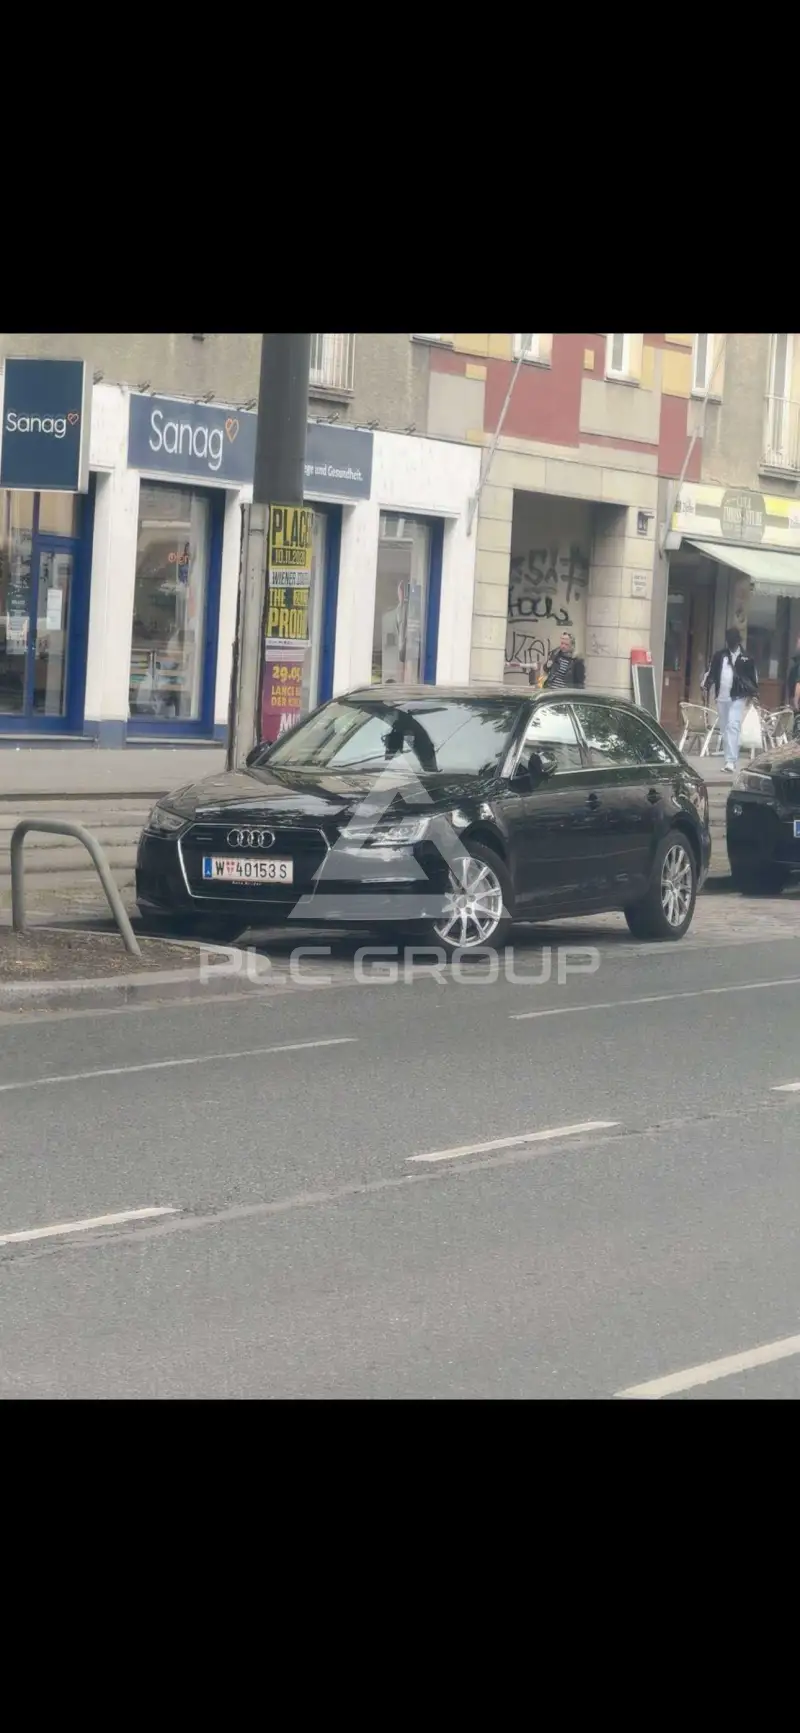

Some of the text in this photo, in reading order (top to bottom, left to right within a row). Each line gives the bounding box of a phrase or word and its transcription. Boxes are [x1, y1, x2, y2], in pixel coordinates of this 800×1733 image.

[5, 412, 67, 439] Sanag
[149, 409, 224, 471] Sanag
[269, 588, 286, 607] THE
[215, 861, 225, 876] W
[236, 862, 276, 879] 40153
[279, 863, 288, 879] S
